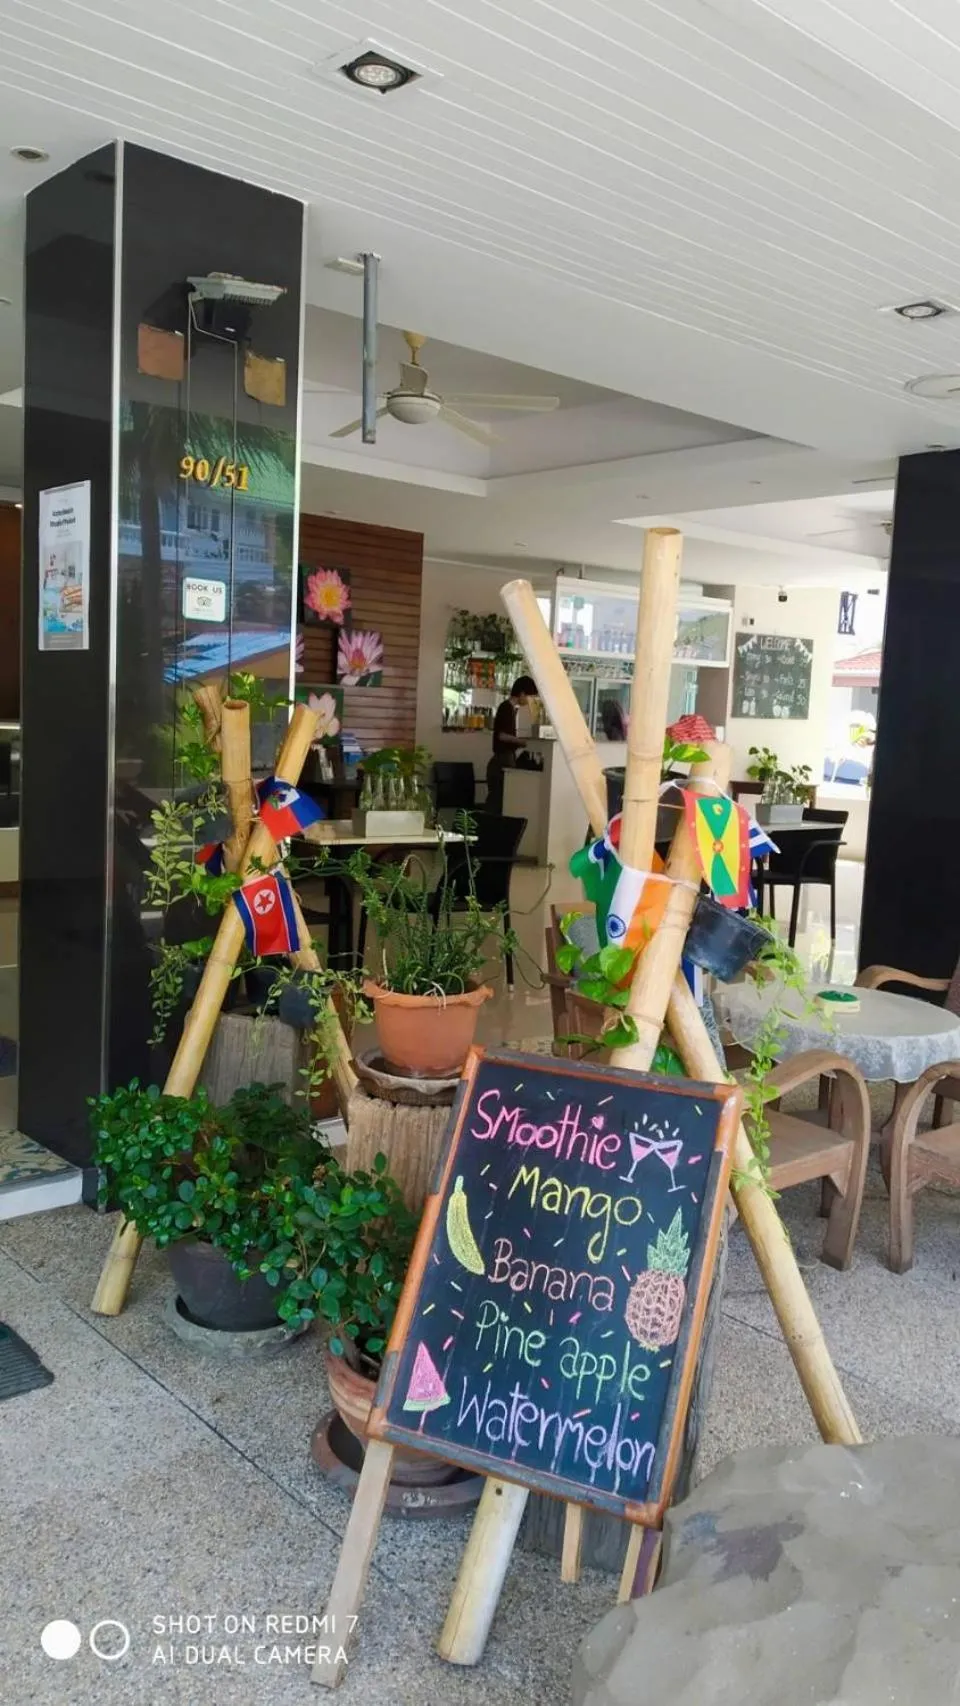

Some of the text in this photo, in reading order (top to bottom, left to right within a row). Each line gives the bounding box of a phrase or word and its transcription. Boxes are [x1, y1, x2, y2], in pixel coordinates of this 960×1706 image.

[179, 455, 249, 491] 90/51
[507, 1165, 643, 1264] Mango
[488, 1237, 615, 1312] Banana
[474, 1299, 651, 1404] Pine apple
[456, 1376, 656, 1485] Watermelon
